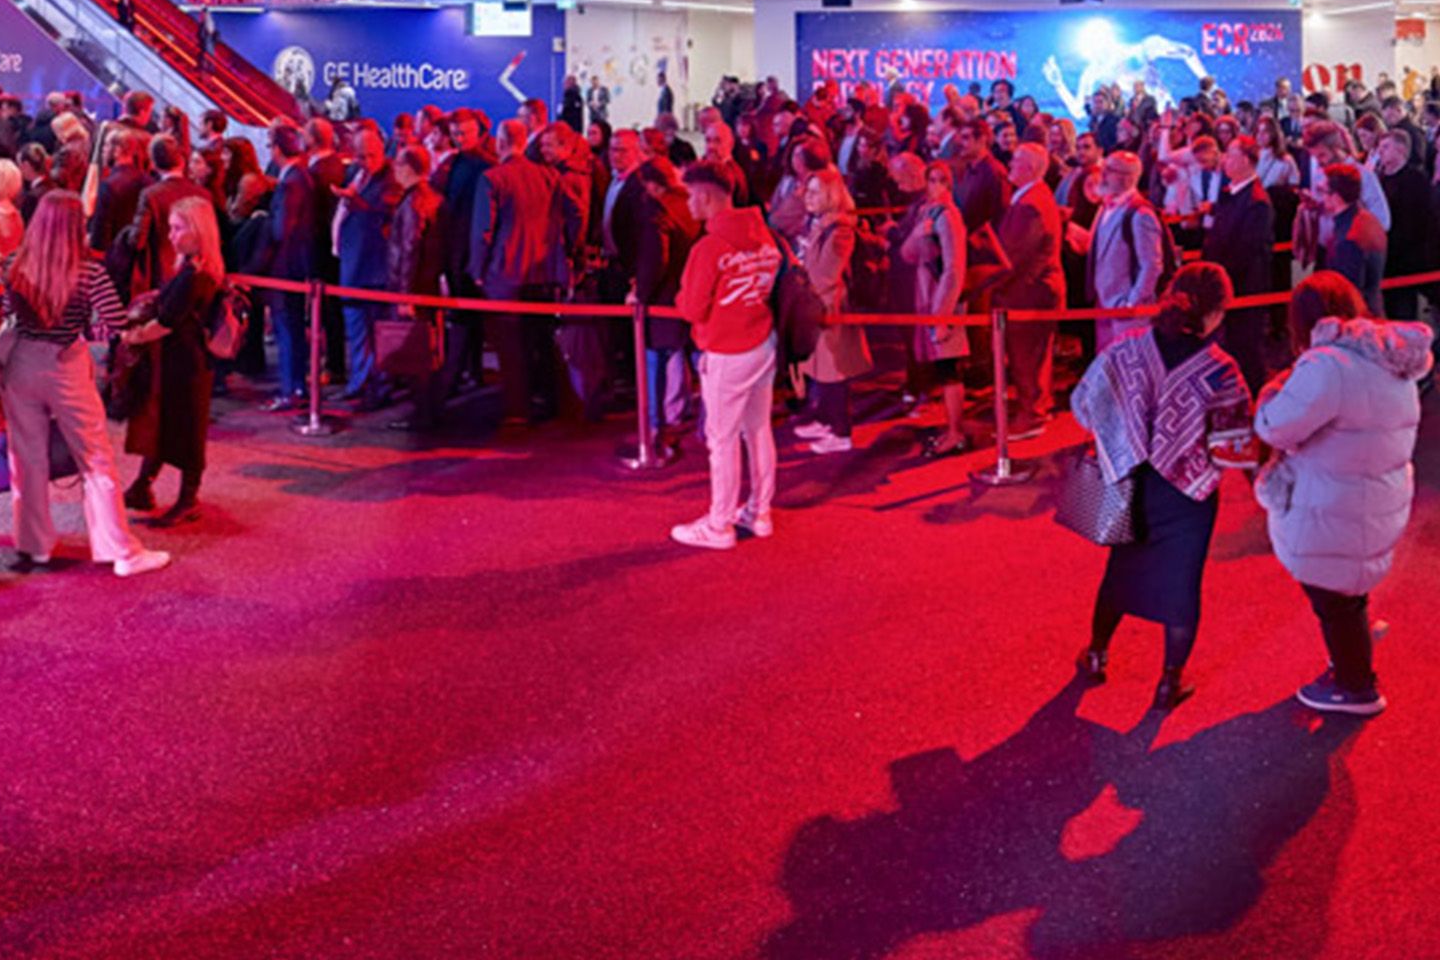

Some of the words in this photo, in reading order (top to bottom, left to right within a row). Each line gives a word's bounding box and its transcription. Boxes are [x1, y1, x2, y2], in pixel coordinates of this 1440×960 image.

[353, 61, 468, 90] HealthCare
[812, 48, 869, 78] NEXT
[874, 48, 1017, 80] GENERATION
